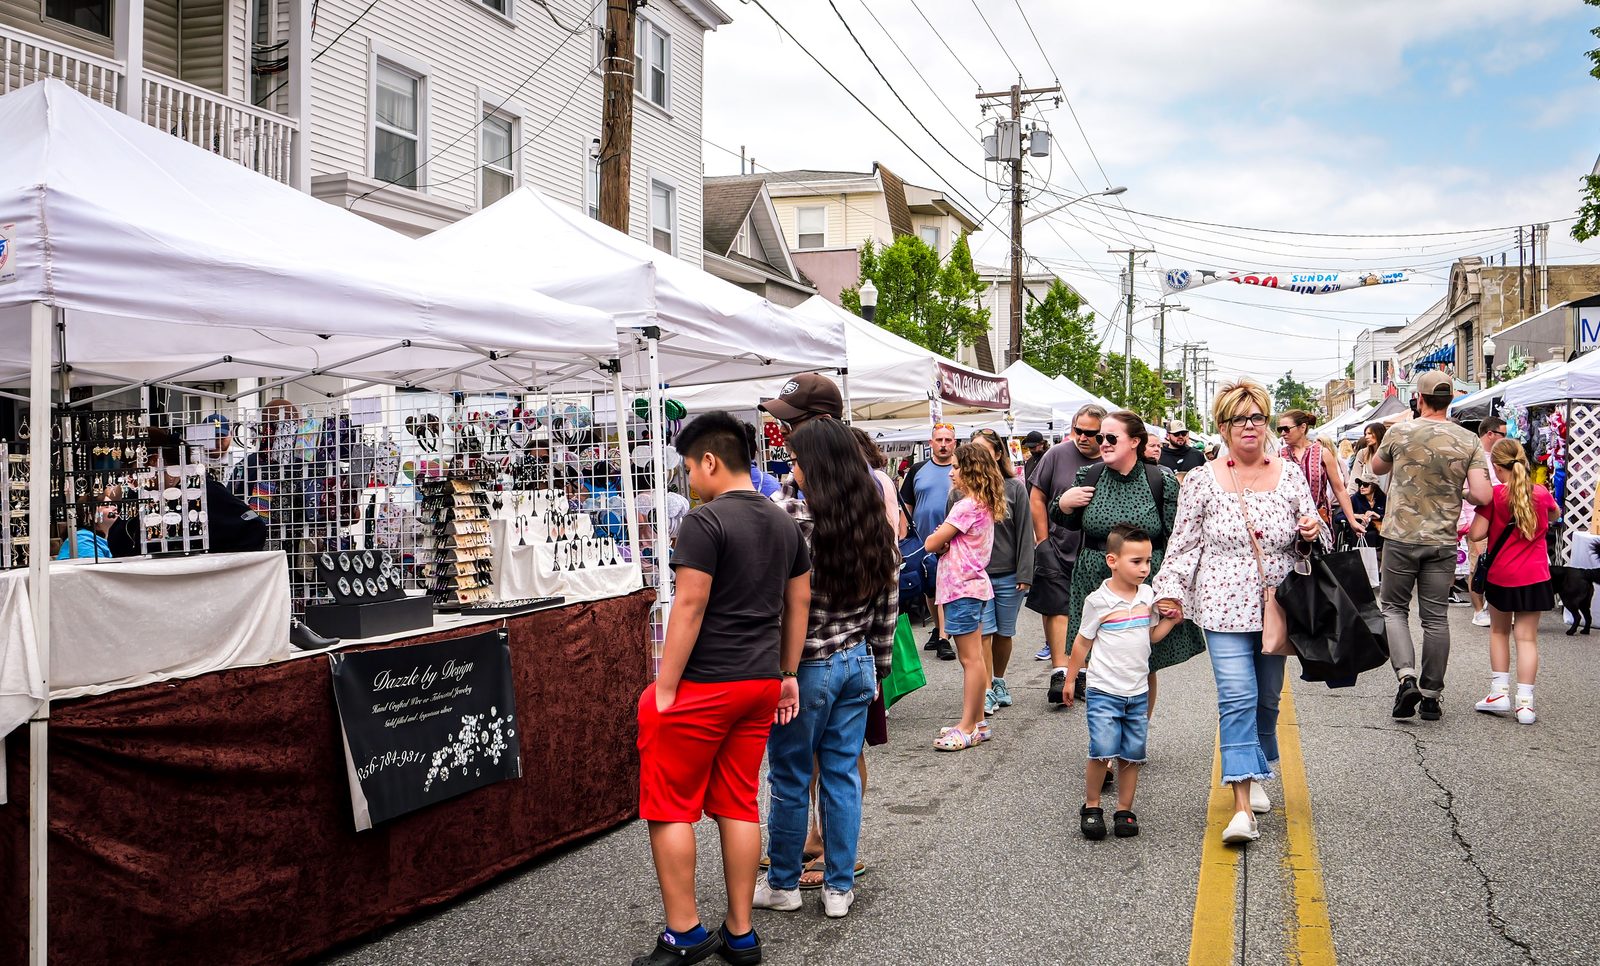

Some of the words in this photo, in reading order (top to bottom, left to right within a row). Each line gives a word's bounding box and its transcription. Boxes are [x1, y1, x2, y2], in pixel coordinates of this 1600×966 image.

[1291, 273, 1339, 283] SUNDAY
[372, 666, 420, 692] Dazzle
[420, 664, 438, 690] by
[441, 659, 474, 682] Design
[357, 750, 426, 781] 856-784-9311
